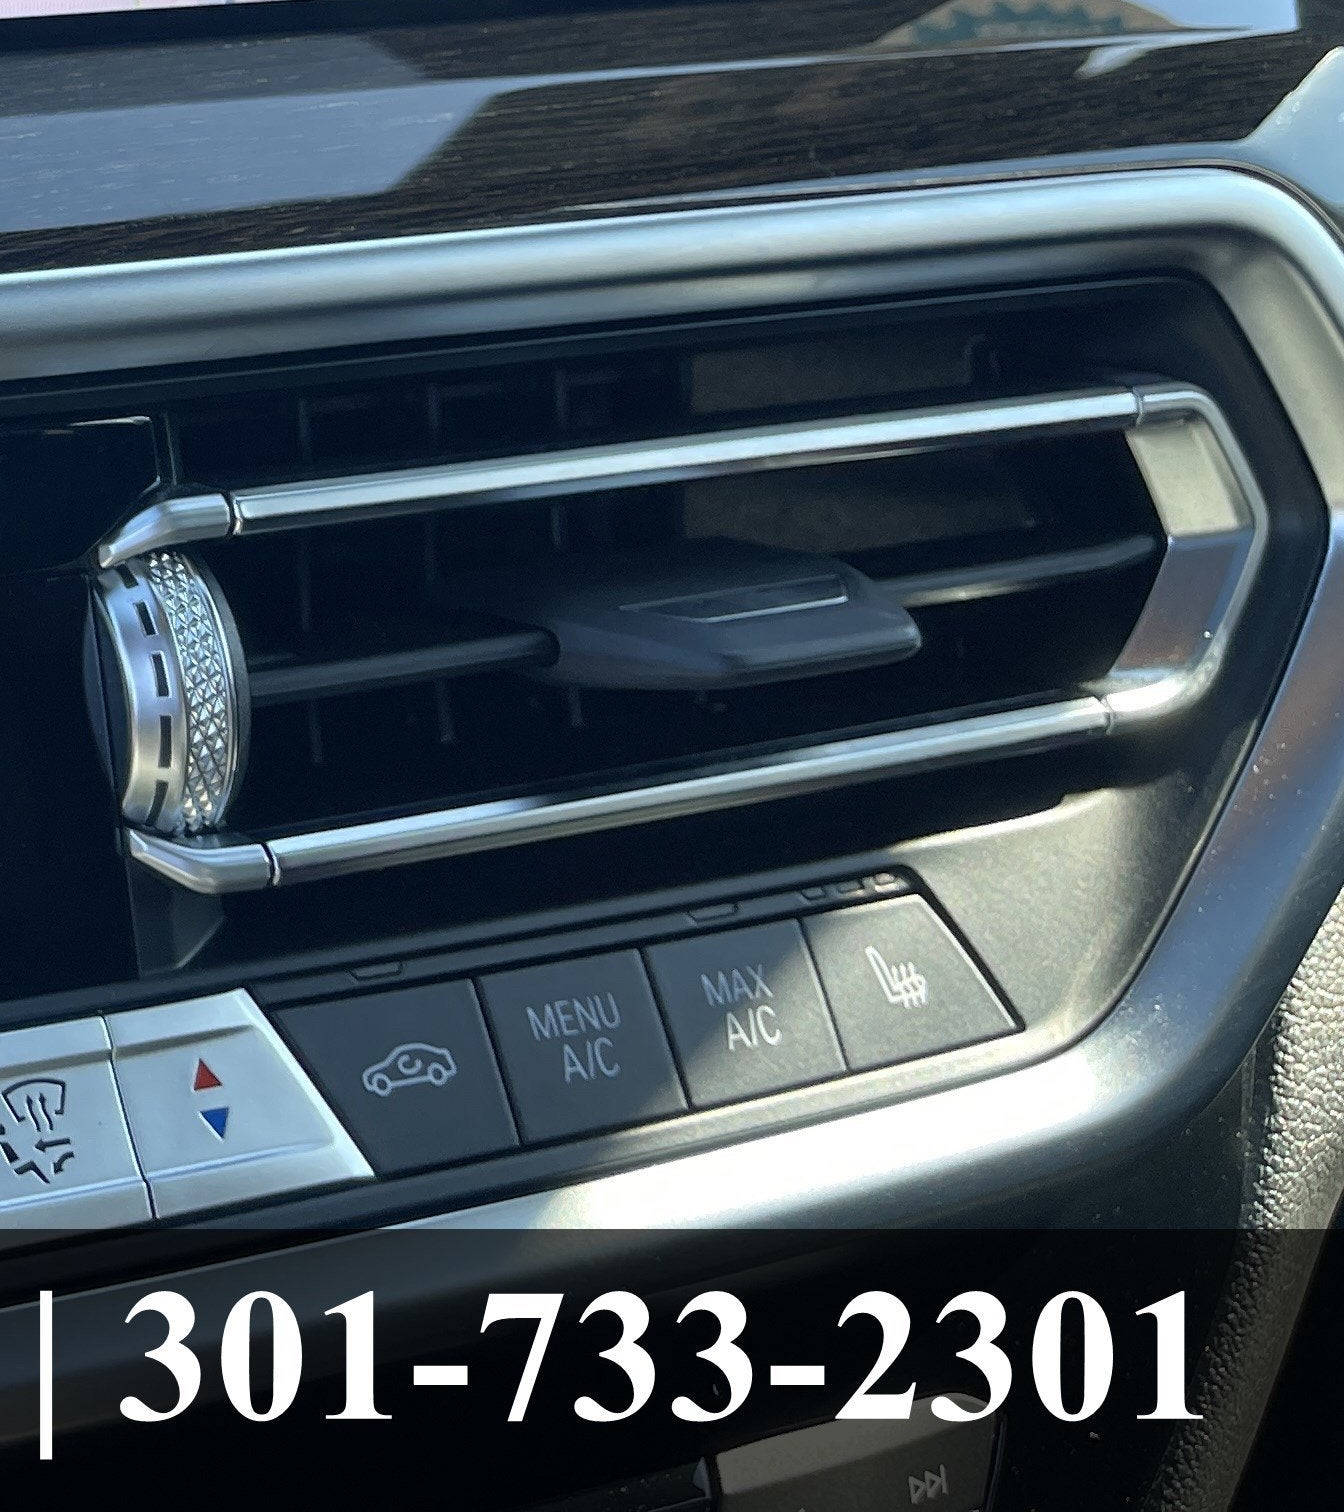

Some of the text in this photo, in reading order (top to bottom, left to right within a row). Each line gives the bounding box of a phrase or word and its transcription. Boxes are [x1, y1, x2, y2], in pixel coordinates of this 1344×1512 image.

[699, 962, 775, 1008] MAX
[528, 991, 623, 1042] MENU
[724, 1006, 783, 1052] A/C
[560, 1040, 622, 1086] A/C
